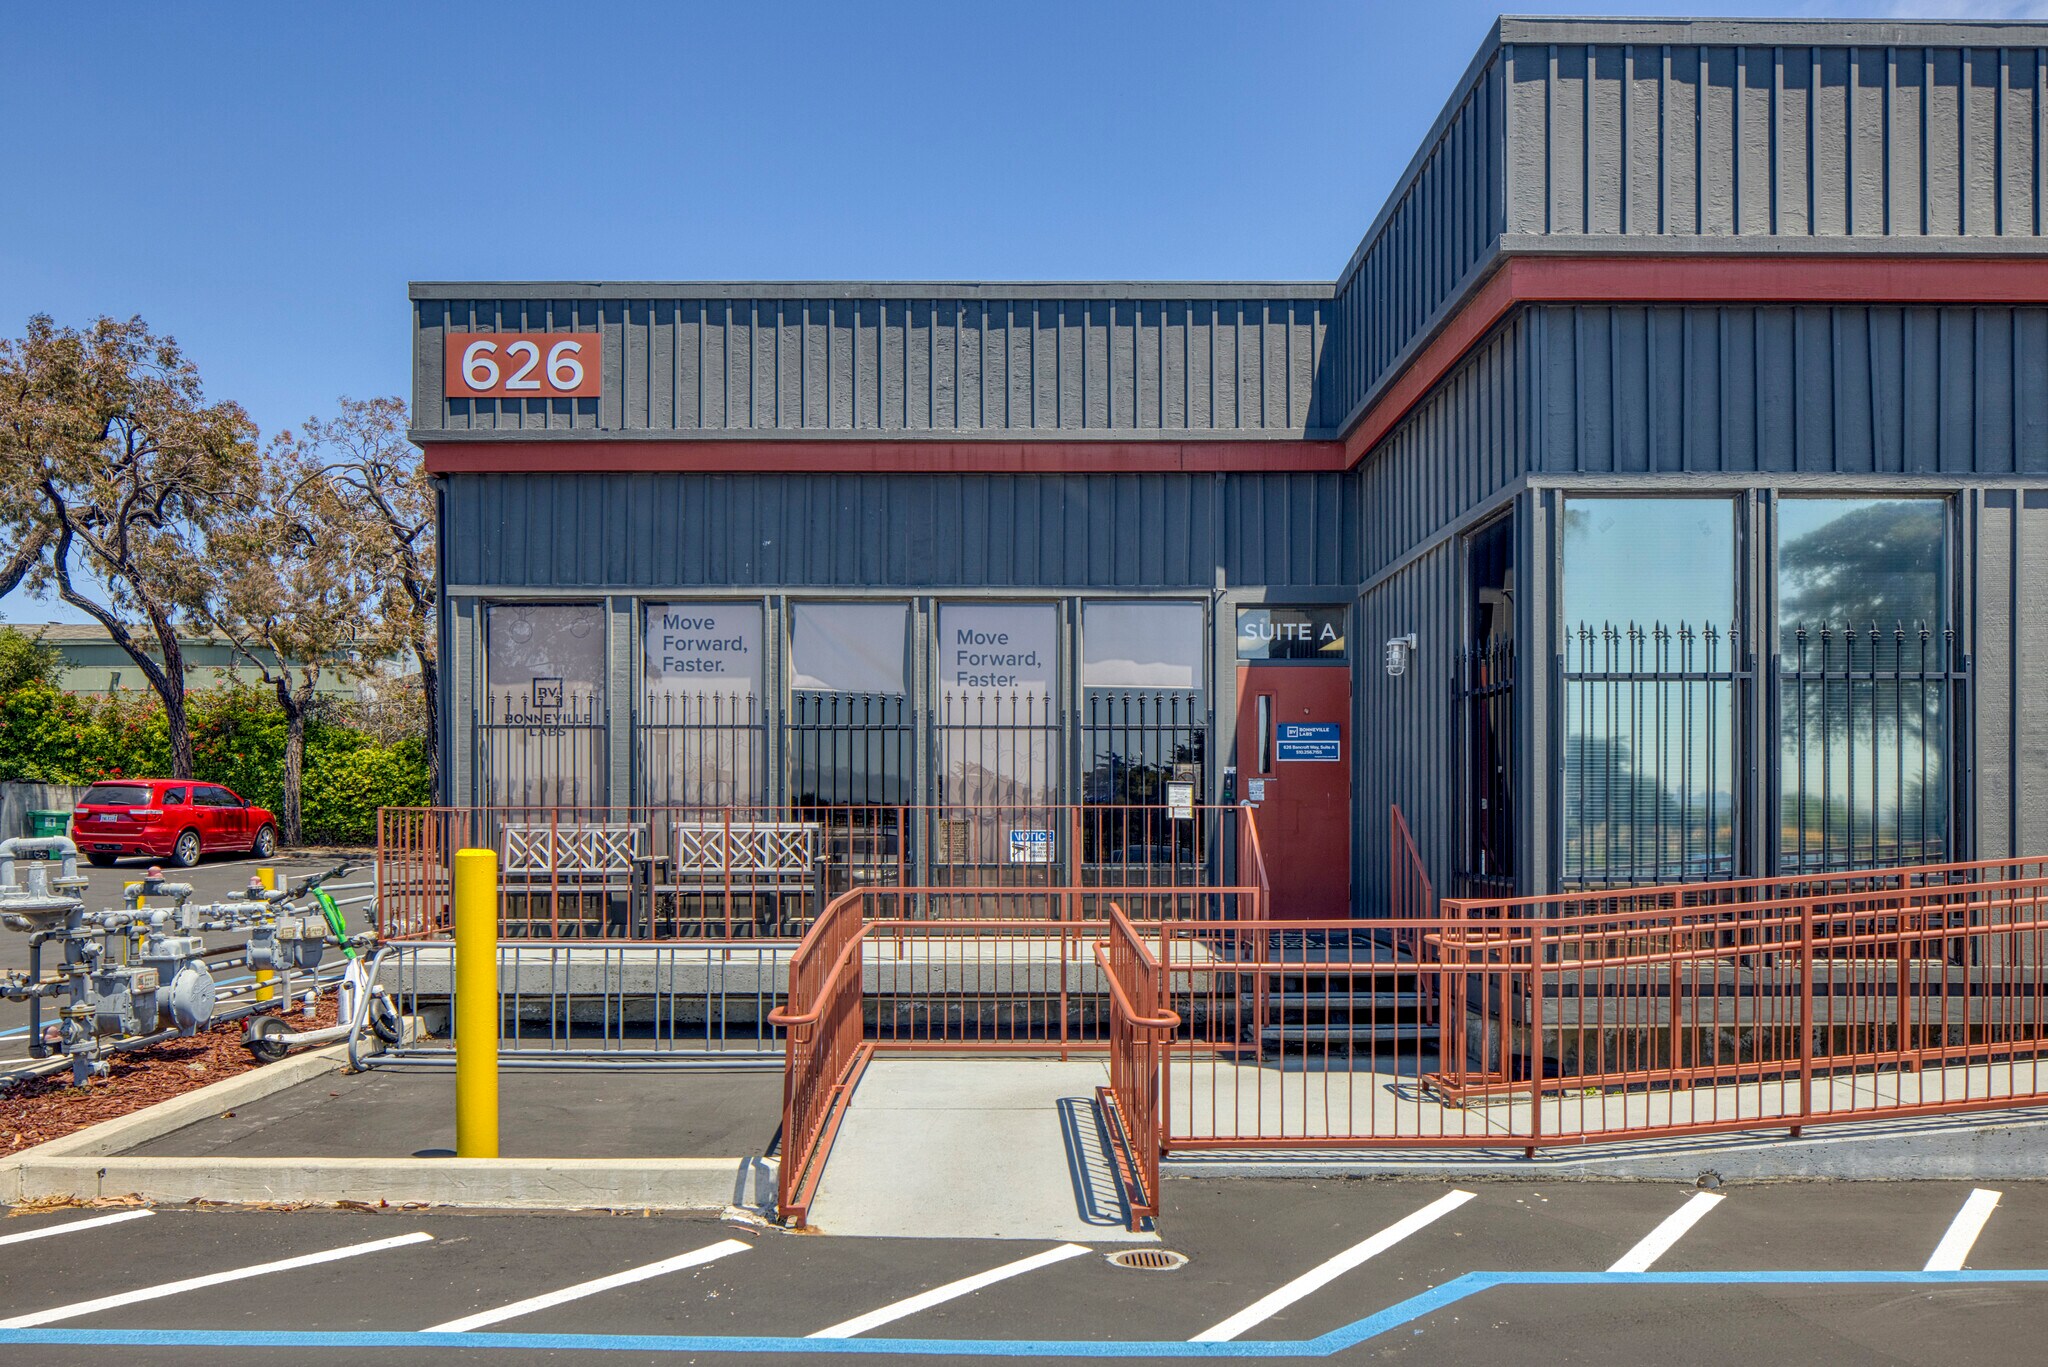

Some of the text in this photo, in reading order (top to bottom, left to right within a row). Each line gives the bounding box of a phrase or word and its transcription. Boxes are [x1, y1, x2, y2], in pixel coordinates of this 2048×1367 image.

[462, 340, 584, 391] 626
[663, 614, 715, 630] Move
[957, 629, 1009, 645] Move
[1245, 623, 1337, 641] SUITE A
[663, 635, 748, 654] Forward,
[663, 656, 725, 672] Faster.
[957, 650, 1042, 669] Forward,
[957, 671, 1019, 687] Faster.
[538, 687, 558, 698] BV
[504, 713, 592, 724] BONNEVILLE
[529, 726, 566, 737] LABS
